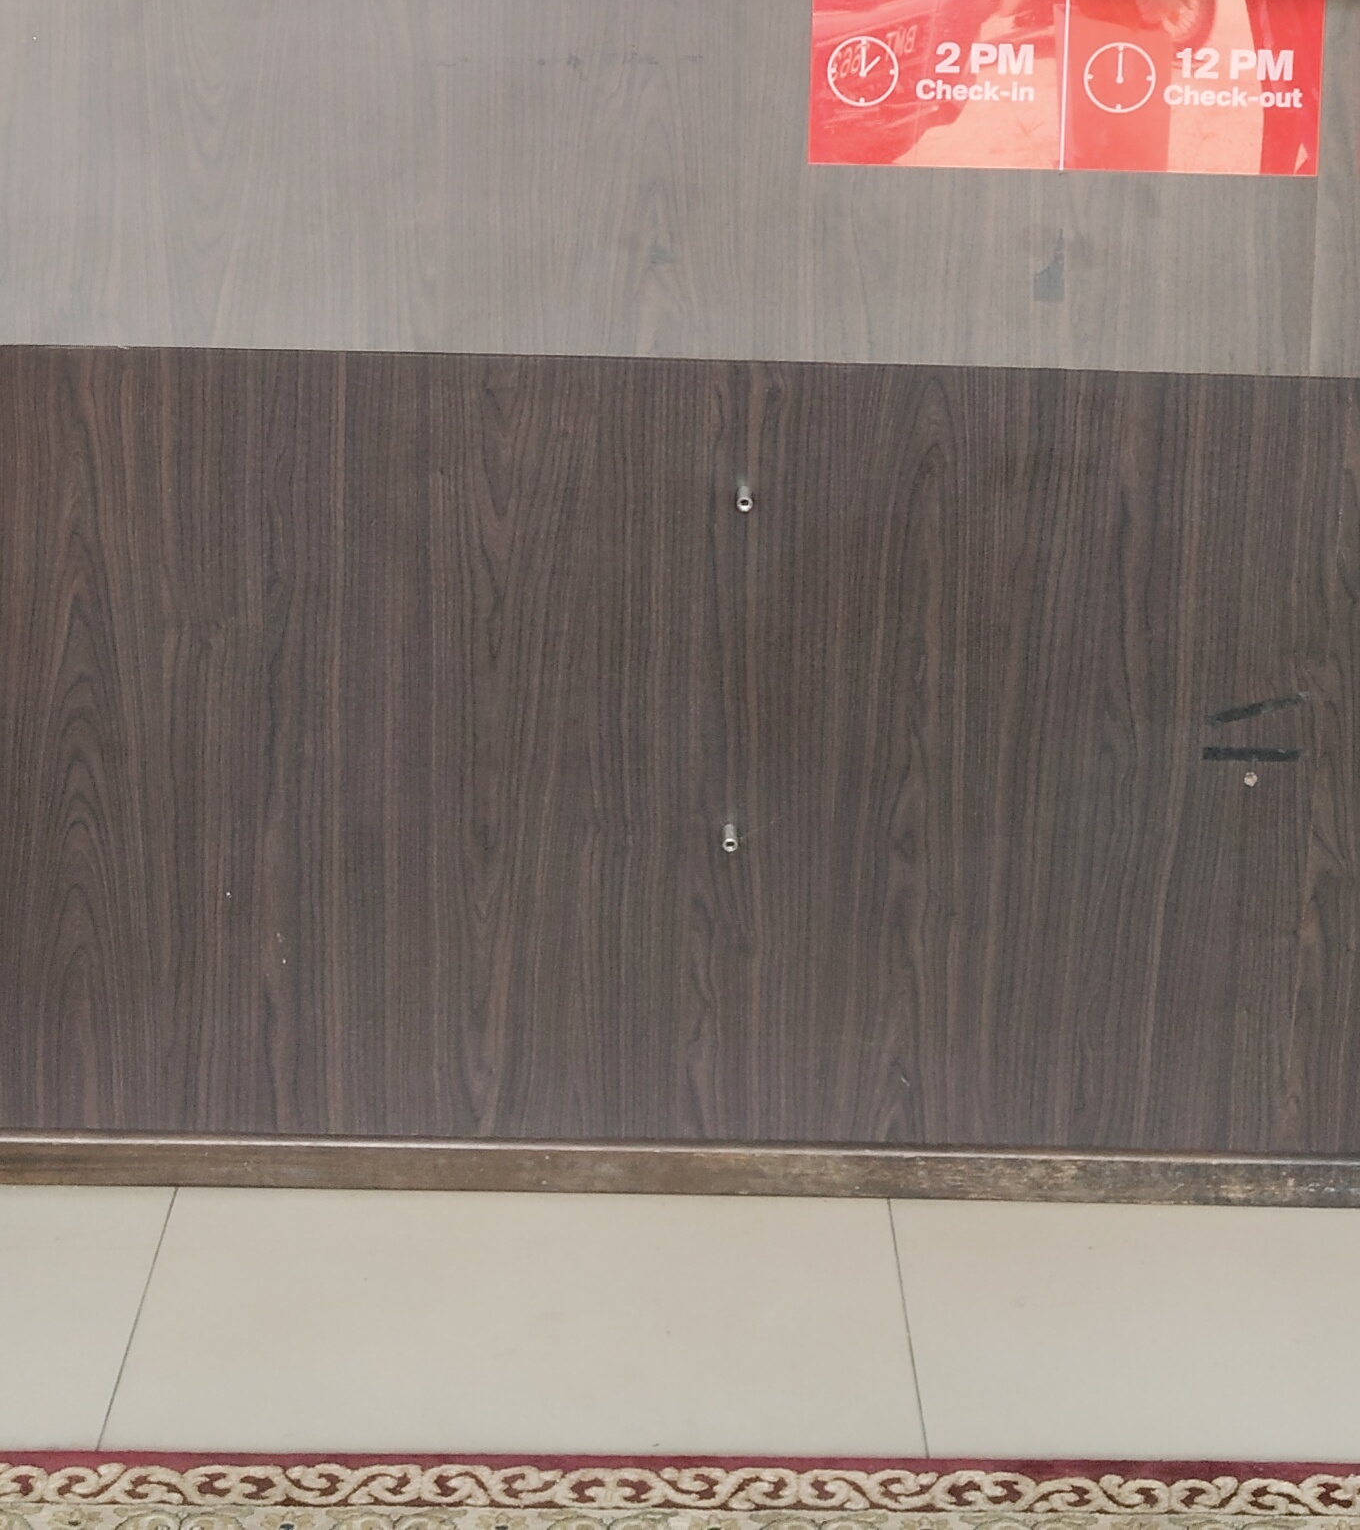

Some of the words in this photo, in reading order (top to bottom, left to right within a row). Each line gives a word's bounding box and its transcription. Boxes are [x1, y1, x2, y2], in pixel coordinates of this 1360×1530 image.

[935, 42, 961, 74] 2
[970, 43, 1035, 75] PM
[1176, 47, 1220, 80] 12
[1229, 48, 1295, 81] PM
[915, 78, 1035, 102] Check-in
[1163, 84, 1303, 108] Check-out
